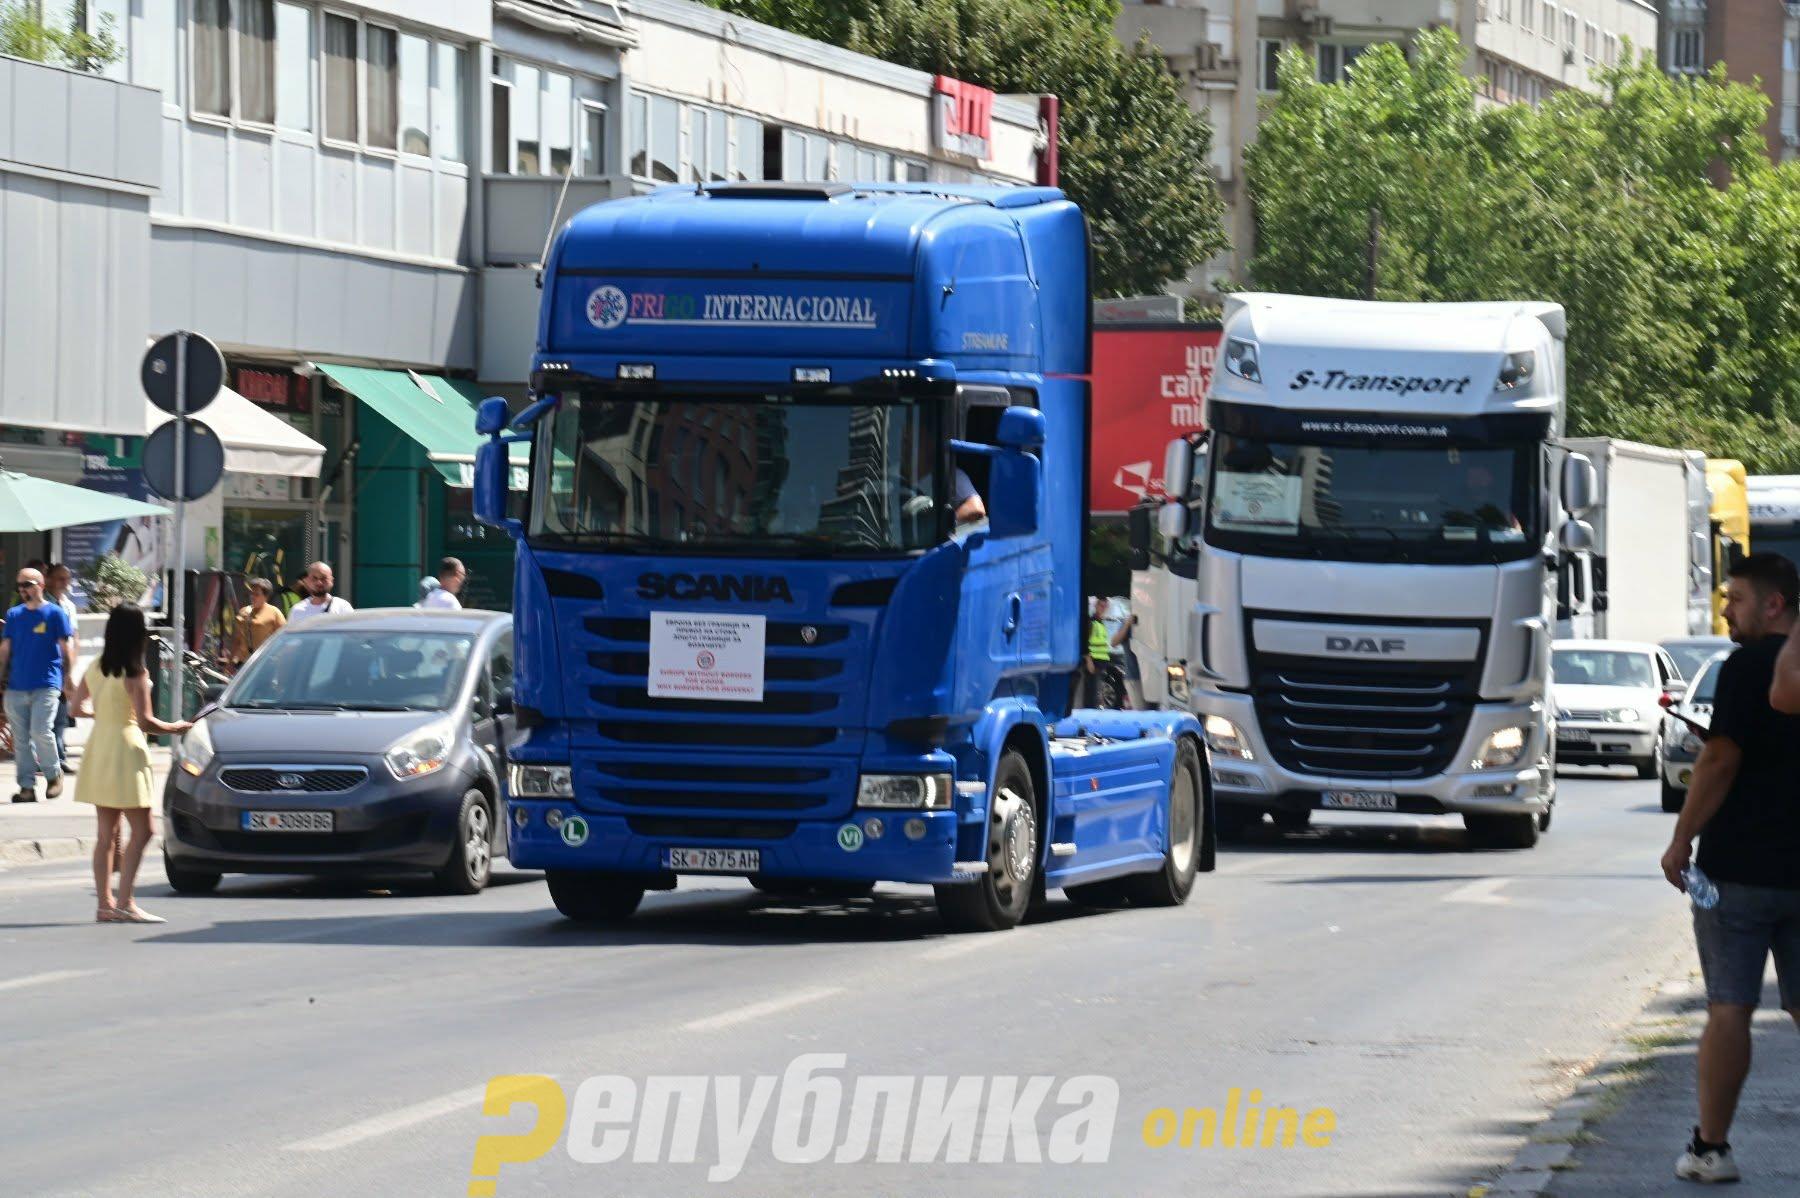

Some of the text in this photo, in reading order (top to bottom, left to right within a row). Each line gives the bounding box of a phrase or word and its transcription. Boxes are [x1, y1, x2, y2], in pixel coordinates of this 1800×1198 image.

[629, 293, 877, 323] FRIGO INTERNACIONAL
[1184, 345, 1216, 376] yo
[1289, 369, 1471, 397] S-Transport
[635, 570, 795, 604] SCANIA
[1325, 636, 1407, 655] DAF
[250, 812, 268, 830] SK
[568, 820, 581, 842] L
[671, 848, 689, 868] SK
[700, 849, 736, 869] 7875
